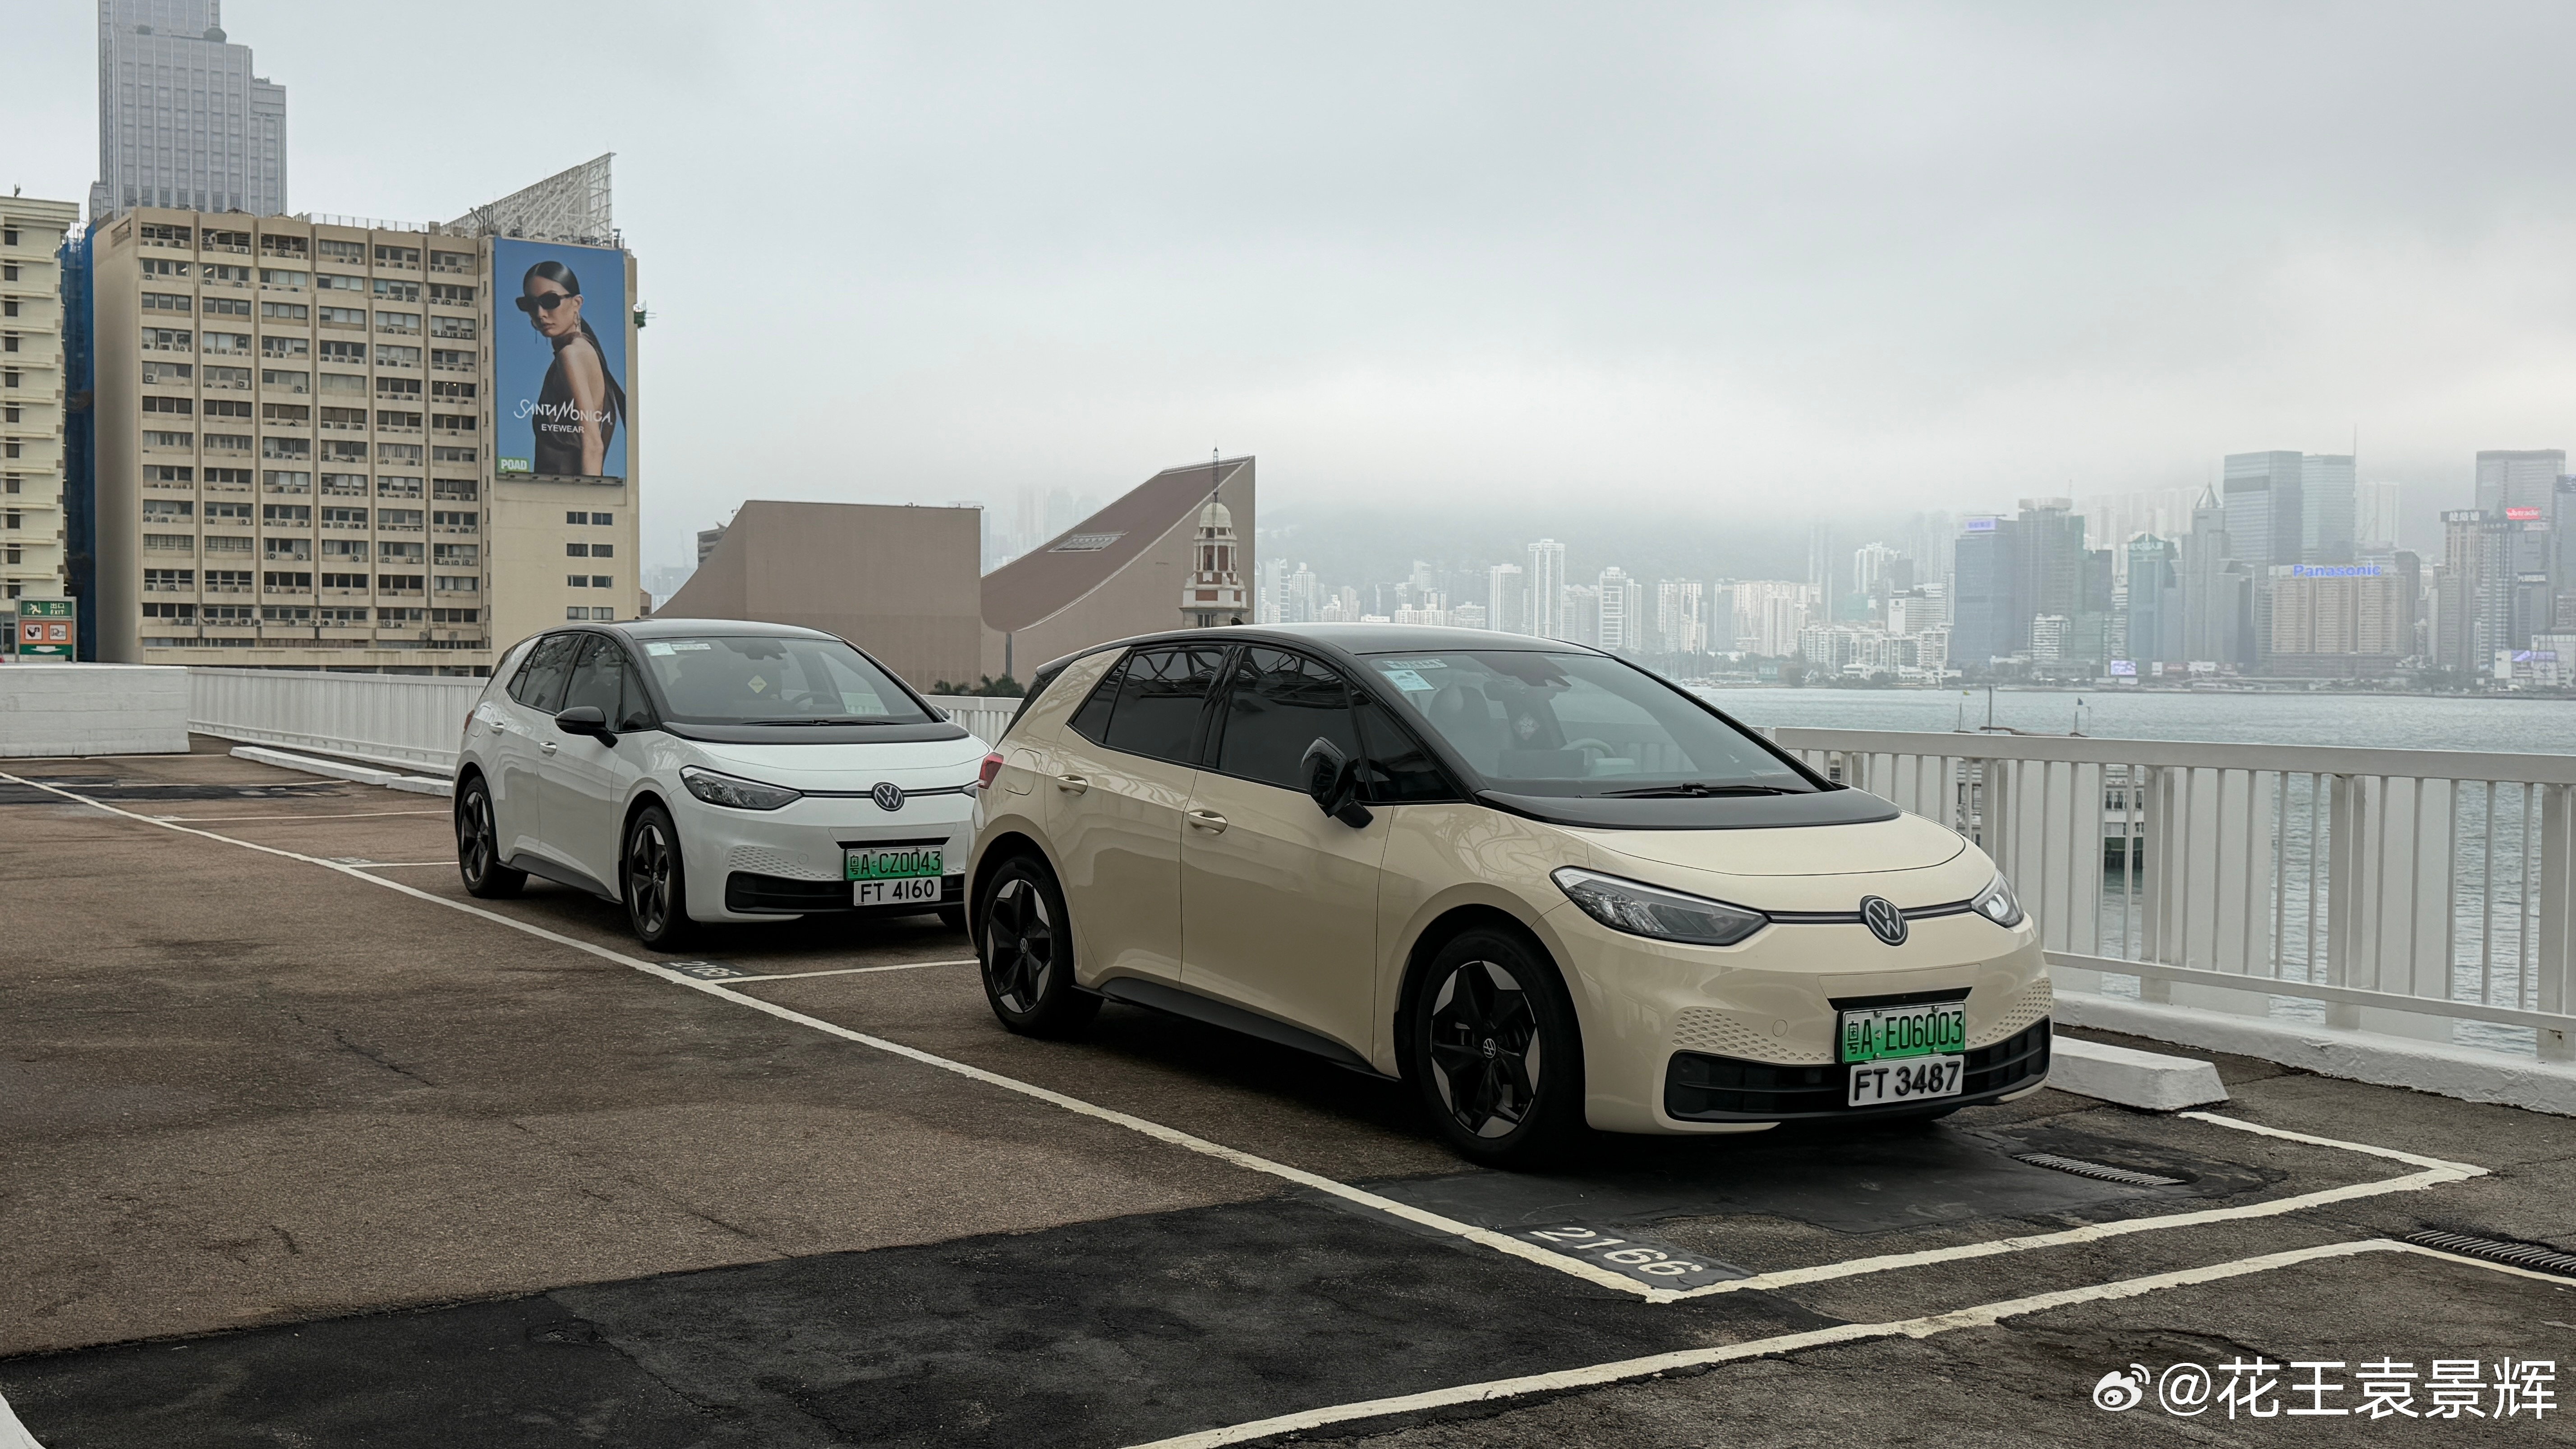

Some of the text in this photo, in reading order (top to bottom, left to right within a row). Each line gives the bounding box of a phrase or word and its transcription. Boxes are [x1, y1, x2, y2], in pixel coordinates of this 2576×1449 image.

[541, 423, 584, 433] EYEWEAR
[501, 459, 527, 469] POAD
[2293, 562, 2381, 577] Panasonic
[860, 879, 934, 902] FT 4160
[1854, 1061, 1960, 1101] FT 3487
[1529, 1227, 1703, 1275] 2166
